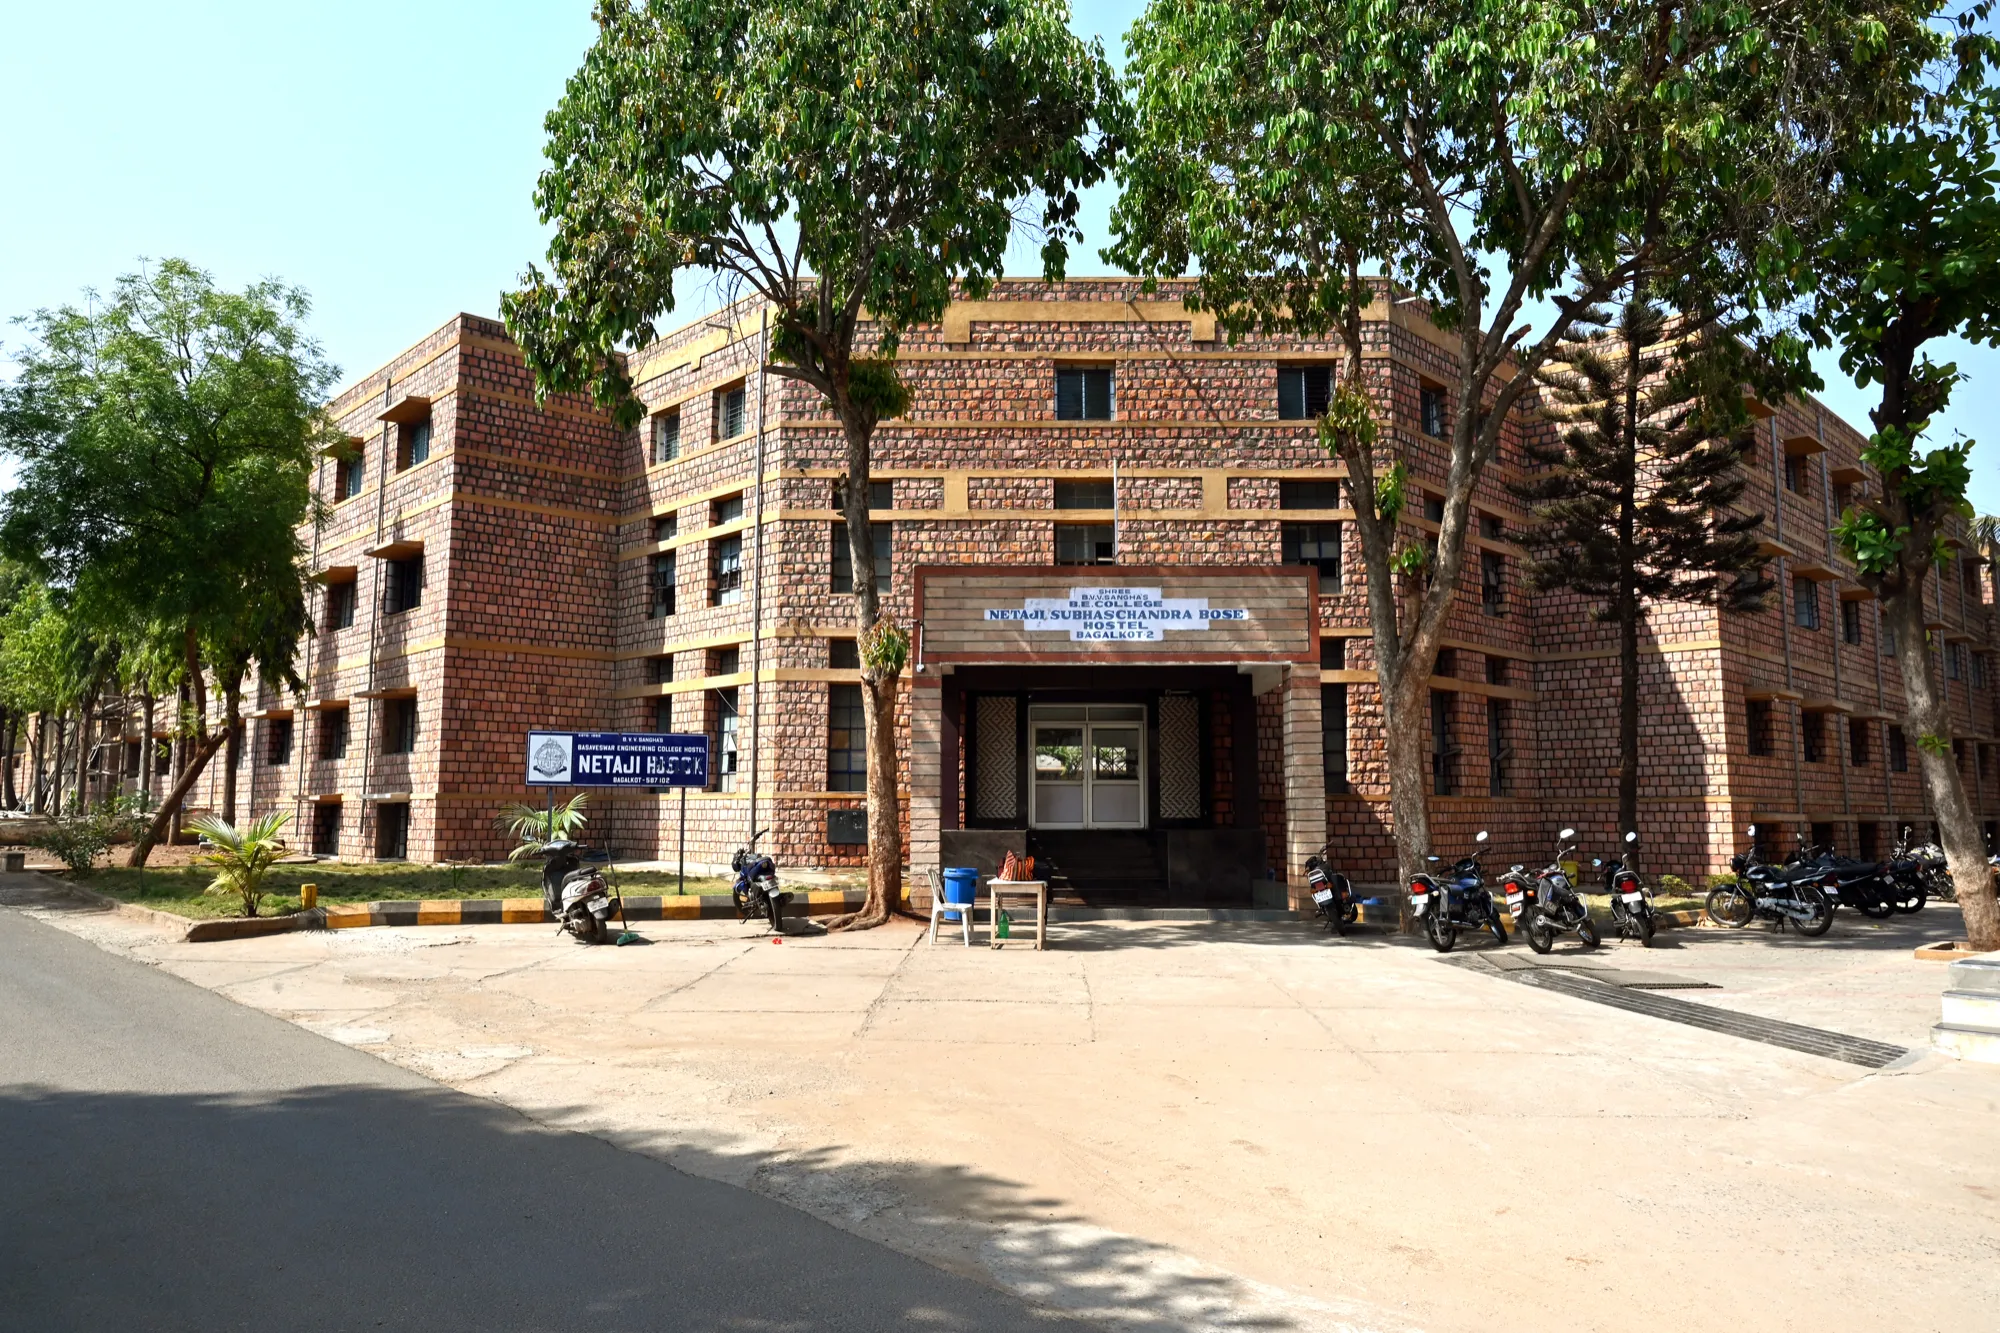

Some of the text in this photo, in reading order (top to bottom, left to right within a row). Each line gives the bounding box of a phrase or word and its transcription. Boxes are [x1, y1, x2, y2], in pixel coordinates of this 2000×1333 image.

[989, 609, 1244, 620] NETAJI SUBHASCHANDRA BOSE
[1083, 621, 1149, 630] HOSTEL
[578, 755, 640, 774] NETAJI
